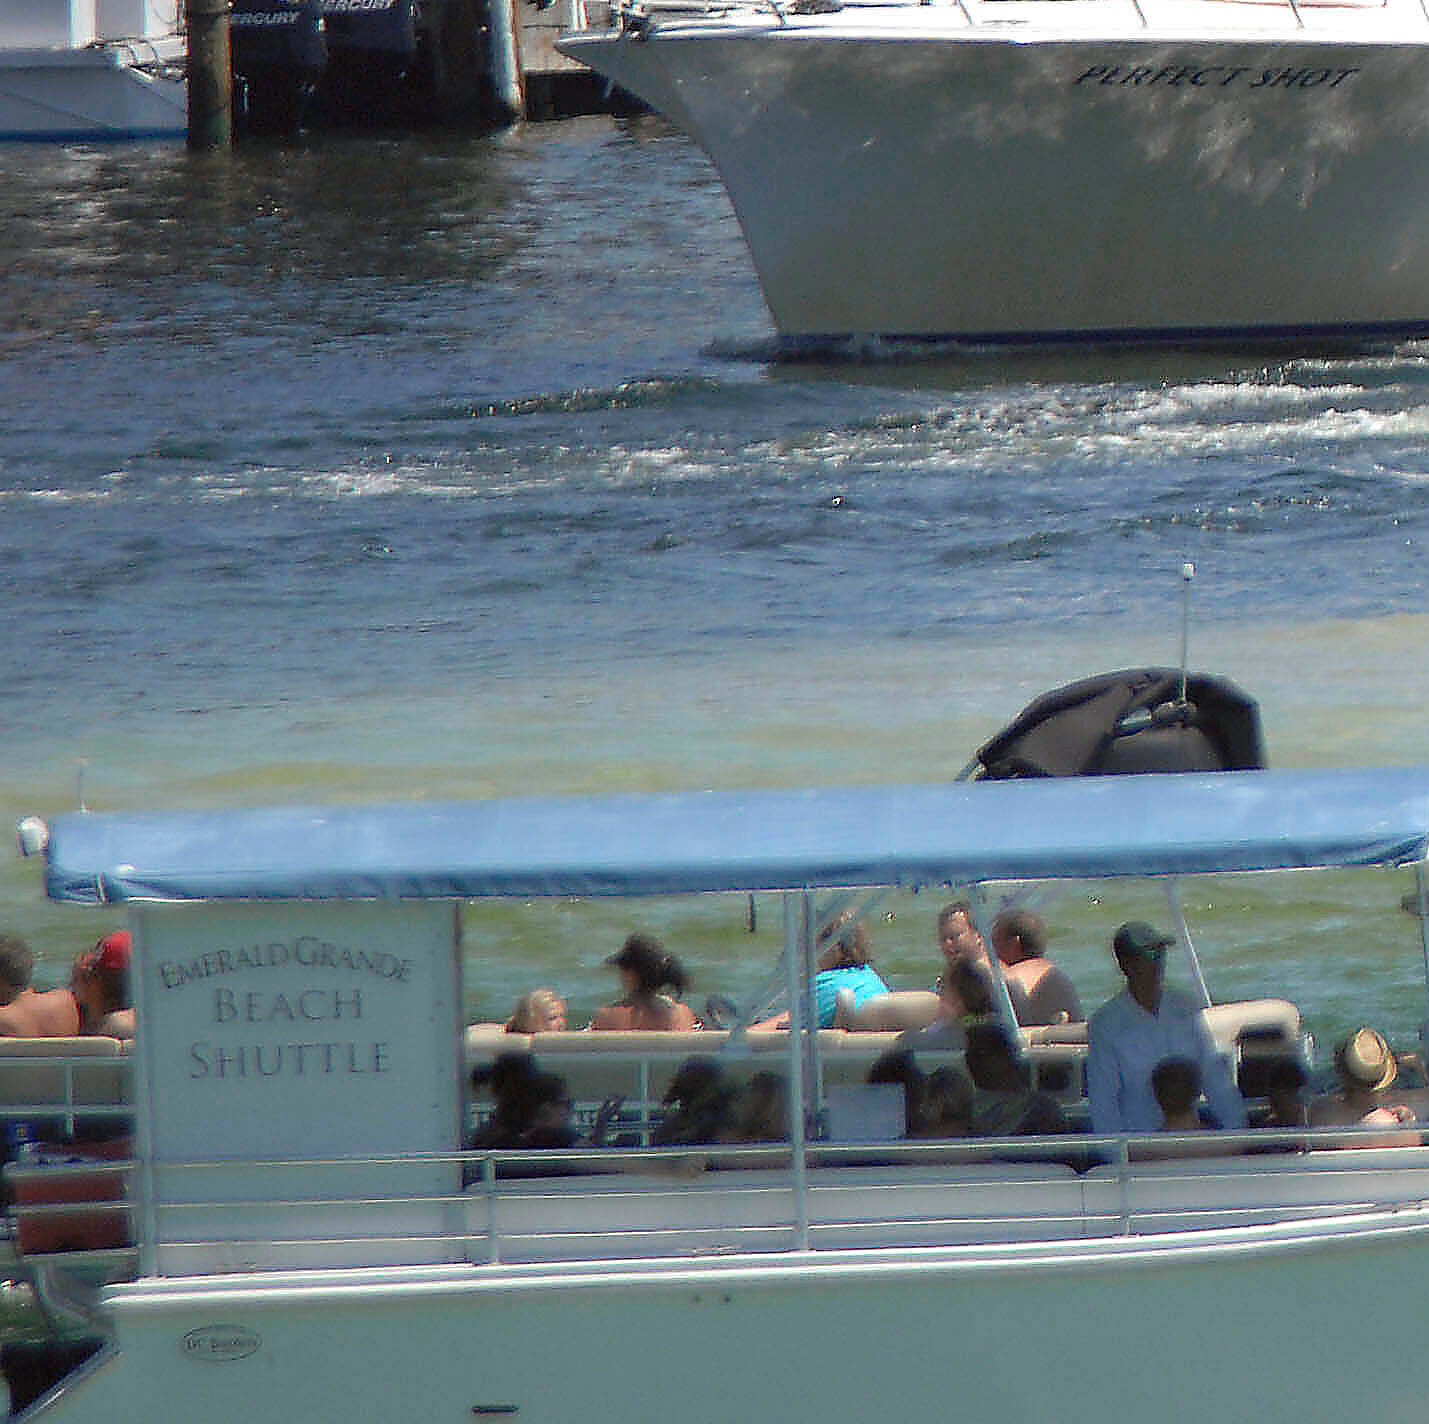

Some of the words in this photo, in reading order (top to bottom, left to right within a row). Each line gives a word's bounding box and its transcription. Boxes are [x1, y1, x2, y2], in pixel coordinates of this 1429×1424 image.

[1073, 64, 1248, 88] PERFECT
[1248, 64, 1359, 88] SHOT
[159, 942, 290, 990] EMERALD
[294, 935, 415, 984] GRANDE
[214, 987, 363, 1024] BEACH
[190, 1040, 391, 1079] SHUTTLE
